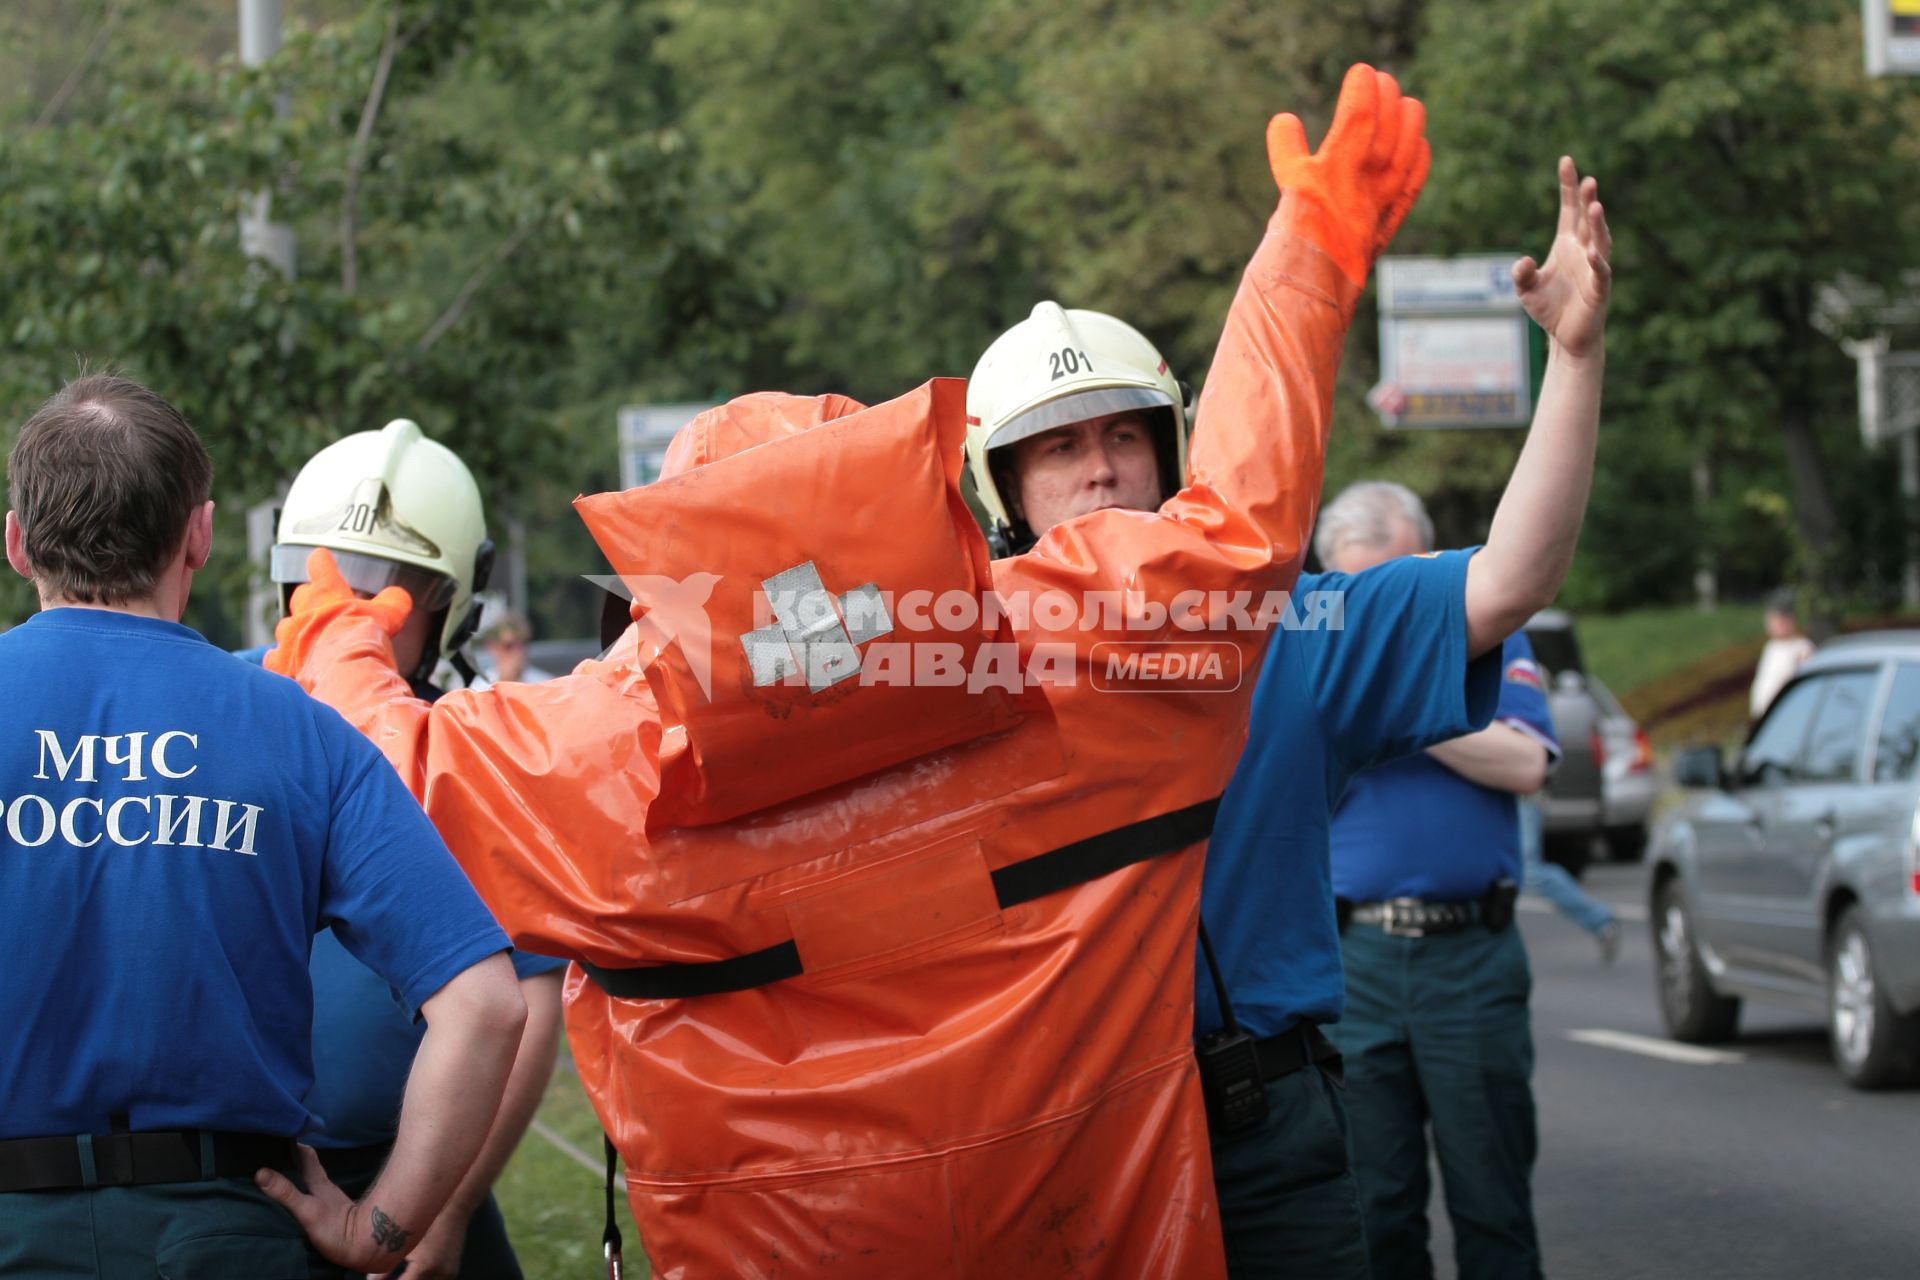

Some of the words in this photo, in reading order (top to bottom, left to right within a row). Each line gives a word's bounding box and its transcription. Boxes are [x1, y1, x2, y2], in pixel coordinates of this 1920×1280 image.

[1049, 347, 1093, 381] 201
[338, 503, 378, 535] 201
[33, 730, 198, 782] МЧС
[0, 794, 264, 855] ОССИИ
